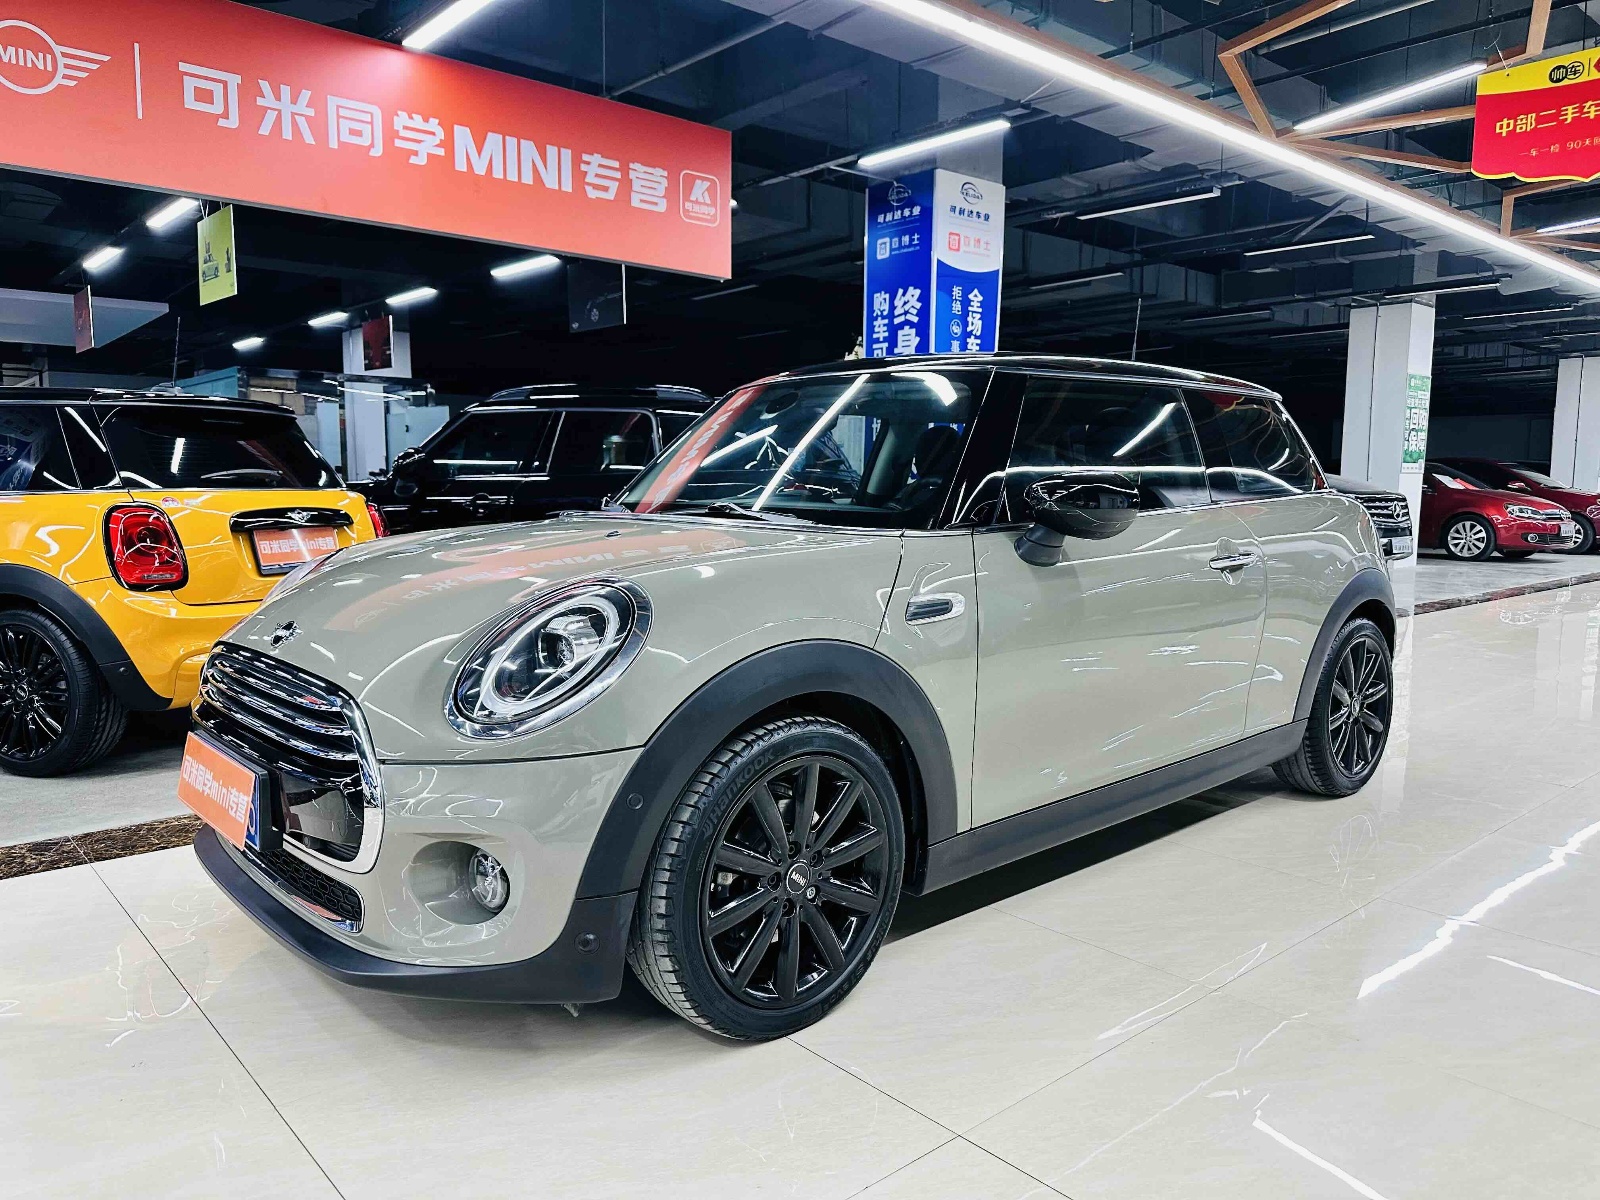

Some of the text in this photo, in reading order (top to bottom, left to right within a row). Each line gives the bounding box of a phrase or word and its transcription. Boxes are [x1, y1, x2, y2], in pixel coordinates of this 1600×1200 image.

[0, 43, 53, 72] MINI
[178, 61, 669, 213] 可米同学MINI专营
[1495, 100, 1600, 137] 中部二手车
[182, 754, 250, 823] 可米同学mini专营
